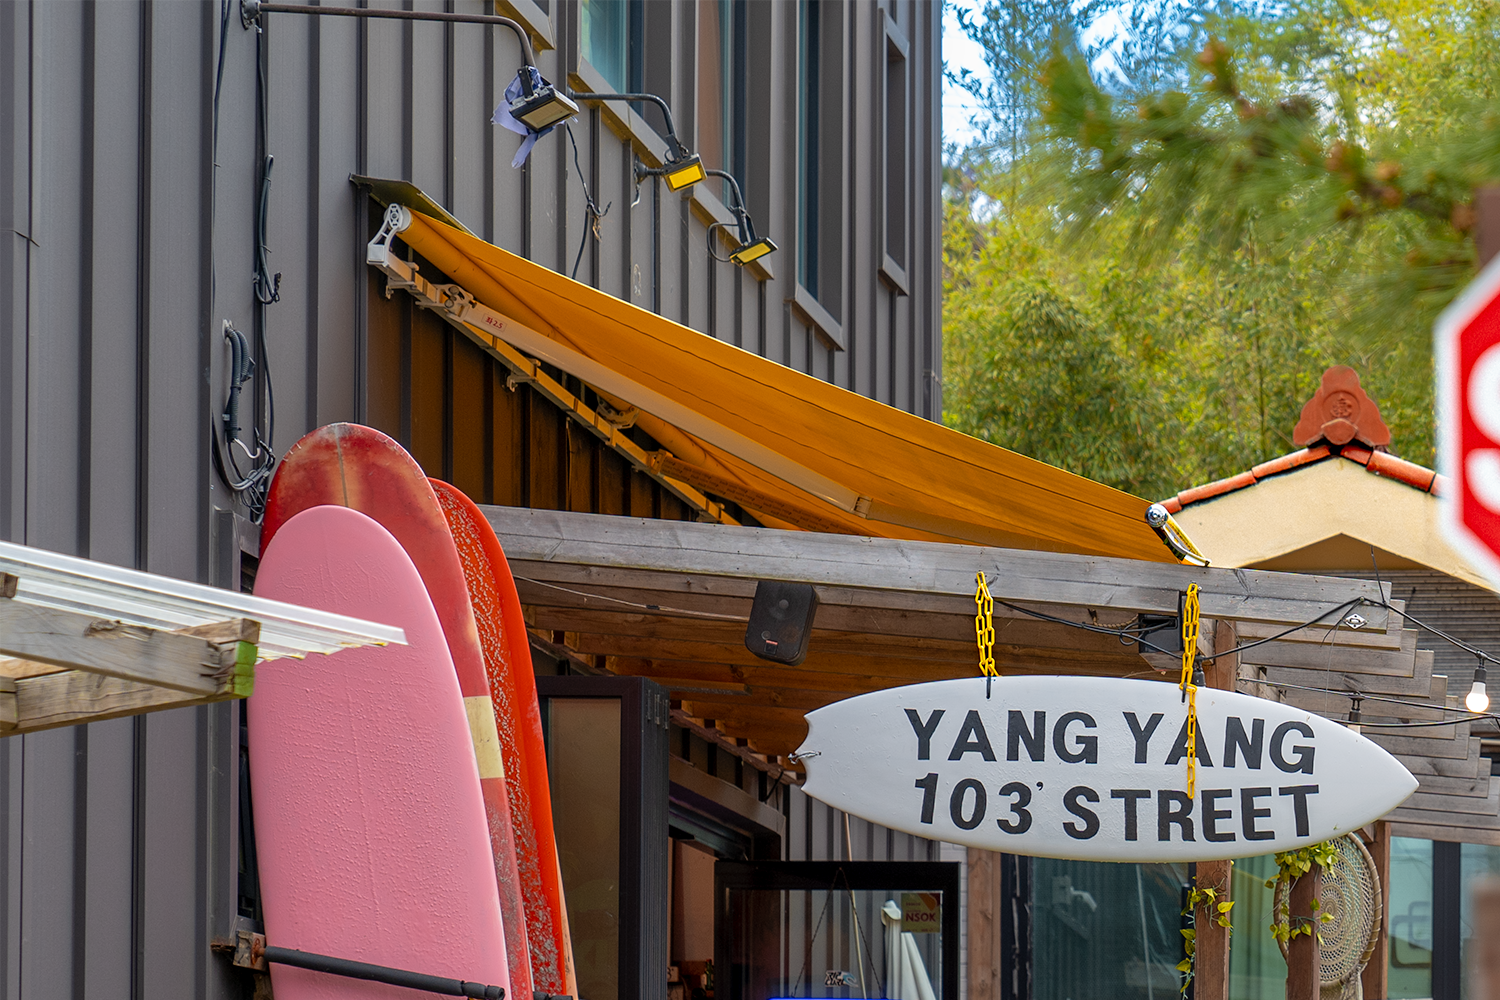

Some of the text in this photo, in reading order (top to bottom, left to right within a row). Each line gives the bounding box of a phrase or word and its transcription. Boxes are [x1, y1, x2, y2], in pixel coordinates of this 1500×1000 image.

[904, 709, 1315, 774] YANG YANG
[1063, 785, 1319, 842] STREET
